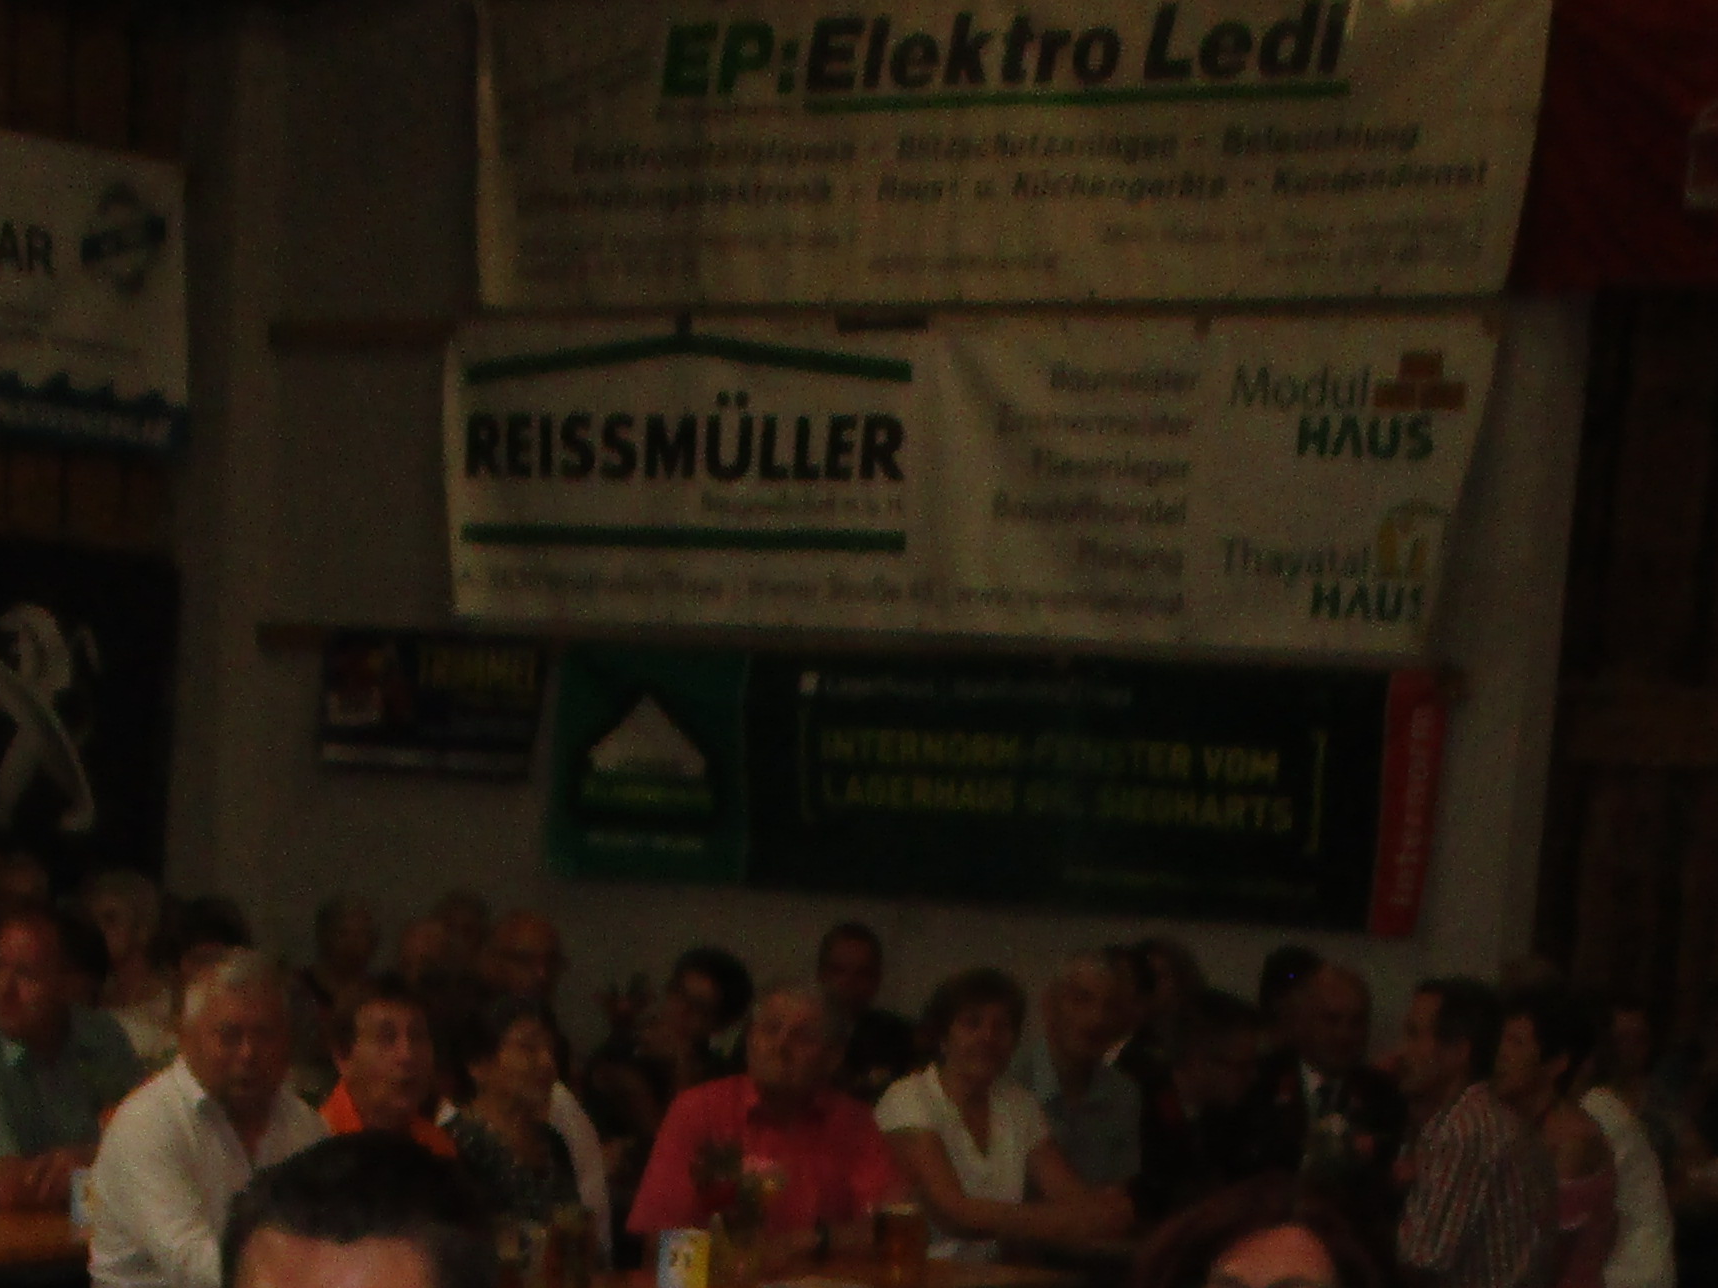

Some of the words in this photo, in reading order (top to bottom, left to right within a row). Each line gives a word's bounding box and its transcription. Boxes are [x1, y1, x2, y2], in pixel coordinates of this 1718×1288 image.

[1230, 365, 1372, 411] Modul
[465, 391, 905, 482] REISSMÜLLER
[1296, 415, 1435, 462] HAUS
[1202, 744, 1281, 786] VOM
